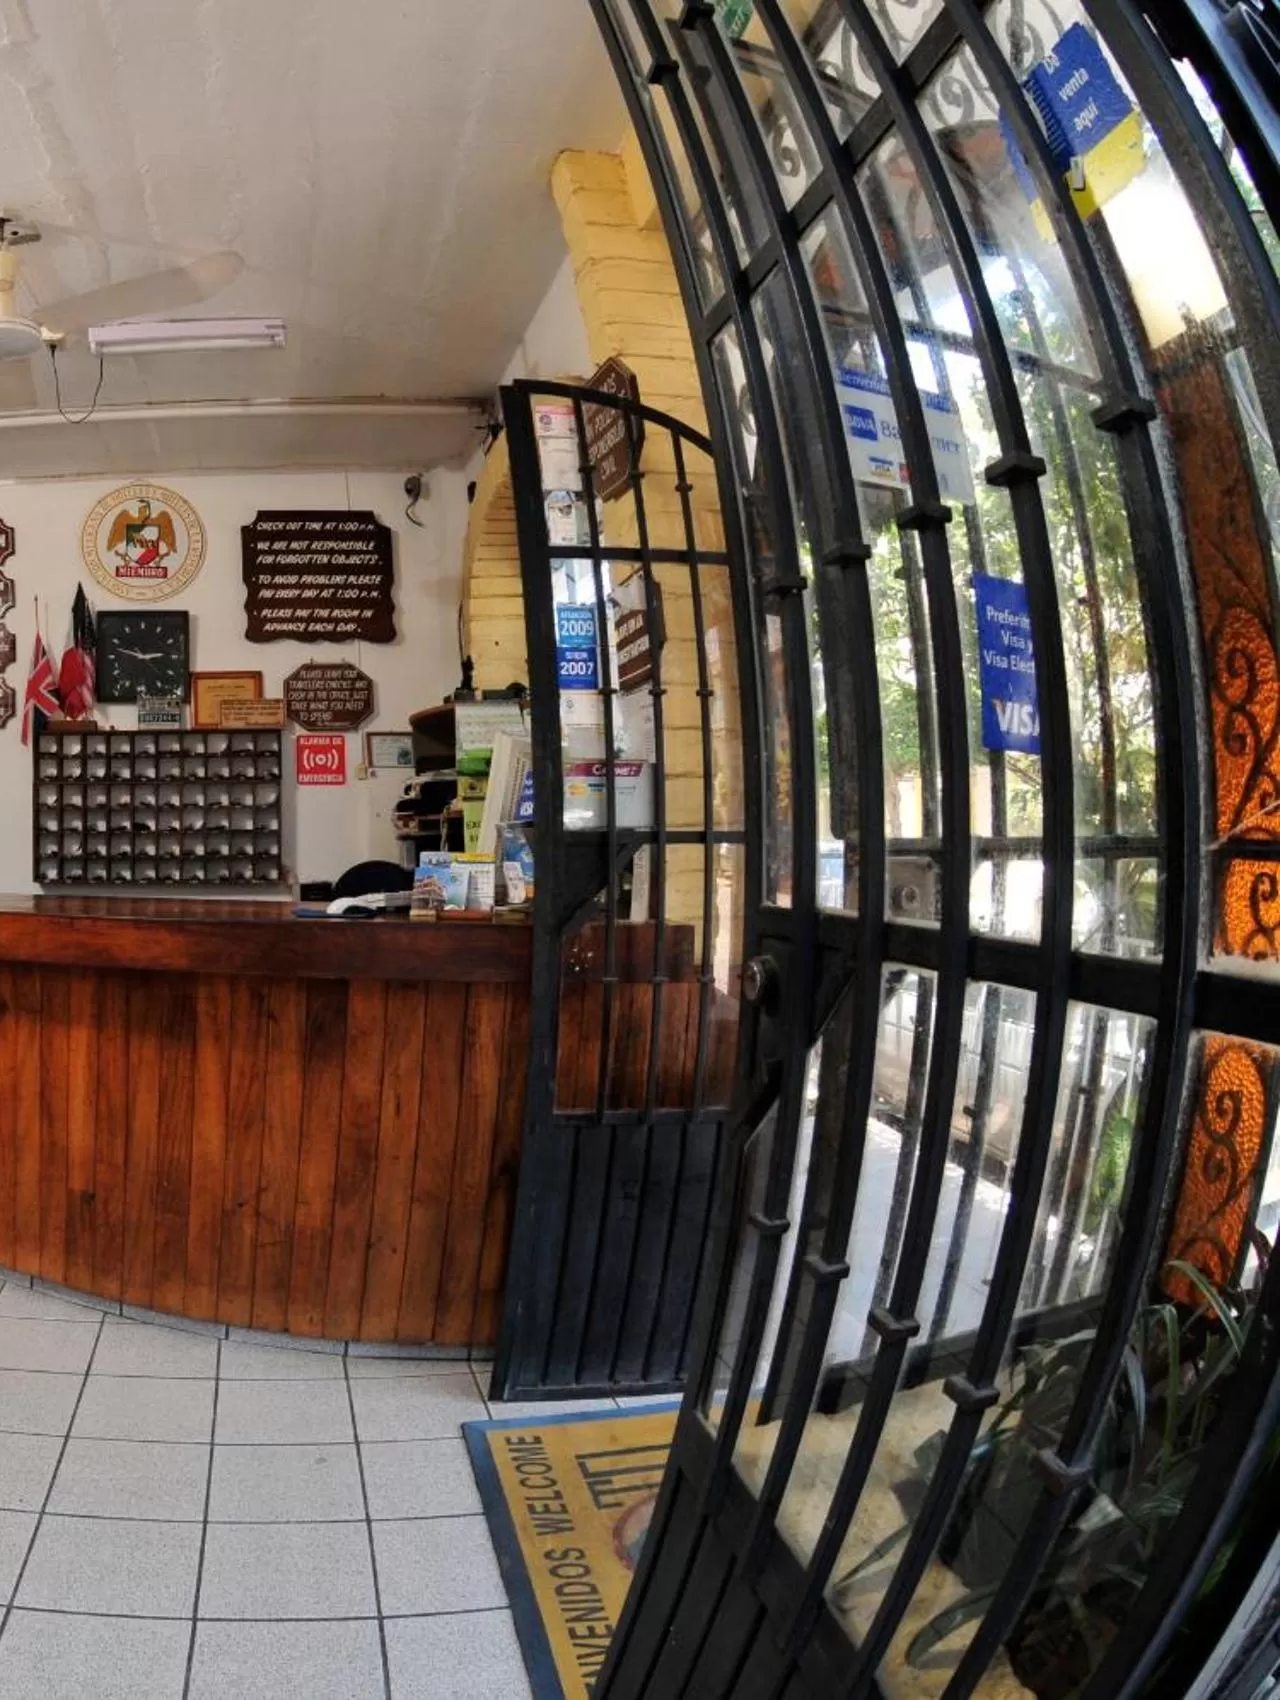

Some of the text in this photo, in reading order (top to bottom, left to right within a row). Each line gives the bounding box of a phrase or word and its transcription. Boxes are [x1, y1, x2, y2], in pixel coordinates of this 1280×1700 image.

[1059, 67, 1089, 101] venta
[257, 521, 285, 531] CHECK
[286, 521, 303, 531] OUT
[305, 521, 323, 531] TIME
[324, 521, 337, 531] AT
[257, 540, 375, 550] WE ARE NOT RESPONSIBLE
[256, 554, 276, 564] FOR
[276, 554, 330, 564] FORGOTTEN
[259, 575, 272, 584] TO
[272, 575, 300, 584] AVOID
[347, 575, 382, 584] PLEASE
[258, 588, 276, 599] PAY
[275, 588, 301, 599] EVERY
[301, 588, 319, 599] DAY
[320, 588, 335, 599] AT
[261, 608, 374, 618] PLEASE PAY THE ROOM IN
[263, 622, 307, 632] ADVANCE
[308, 622, 335, 632] EACH
[561, 620, 594, 636] 2009
[1001, 629, 1026, 649] Visa
[984, 650, 1008, 669] Visa
[560, 661, 594, 675] 2007
[299, 736, 330, 745] ALARMA
[504, 1434, 575, 1537] WELCOME
